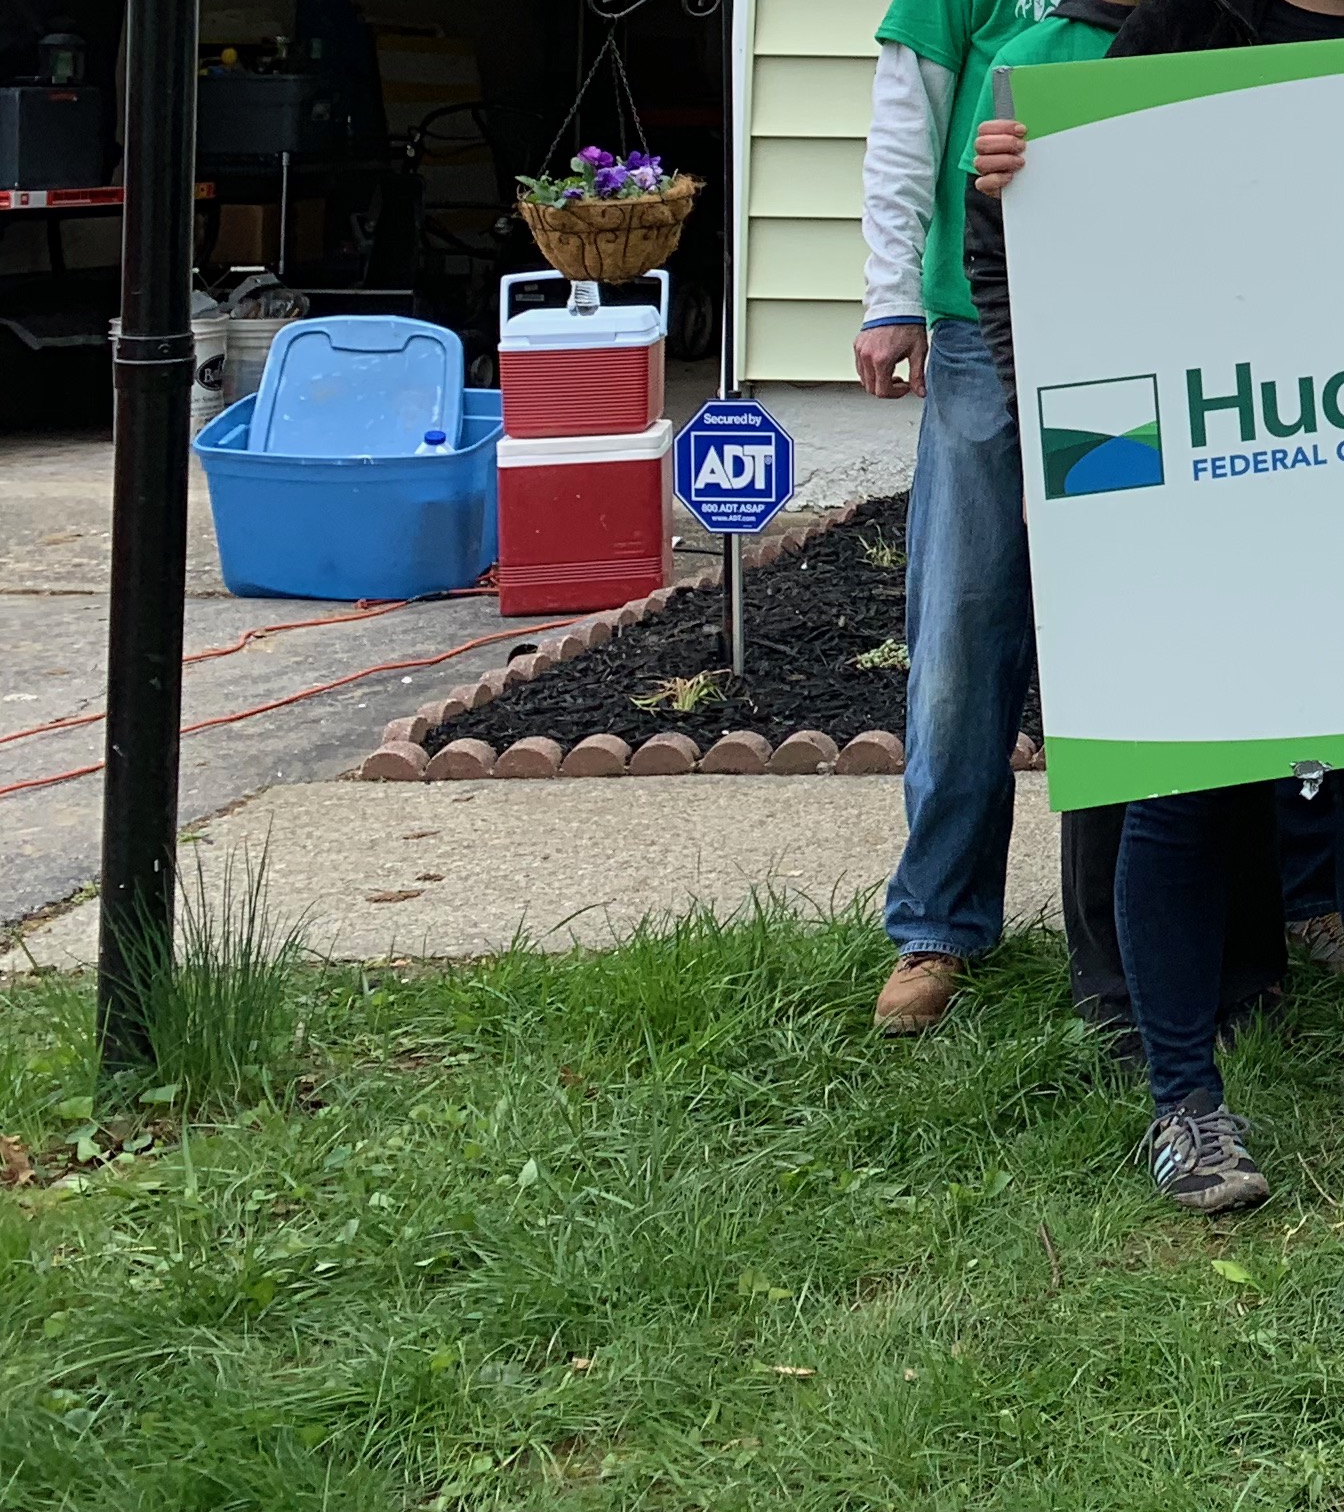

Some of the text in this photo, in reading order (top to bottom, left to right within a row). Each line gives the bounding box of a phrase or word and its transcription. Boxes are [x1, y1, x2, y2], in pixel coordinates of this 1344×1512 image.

[703, 412, 763, 428] Secured by
[1192, 444, 1329, 482] FEDERAL
